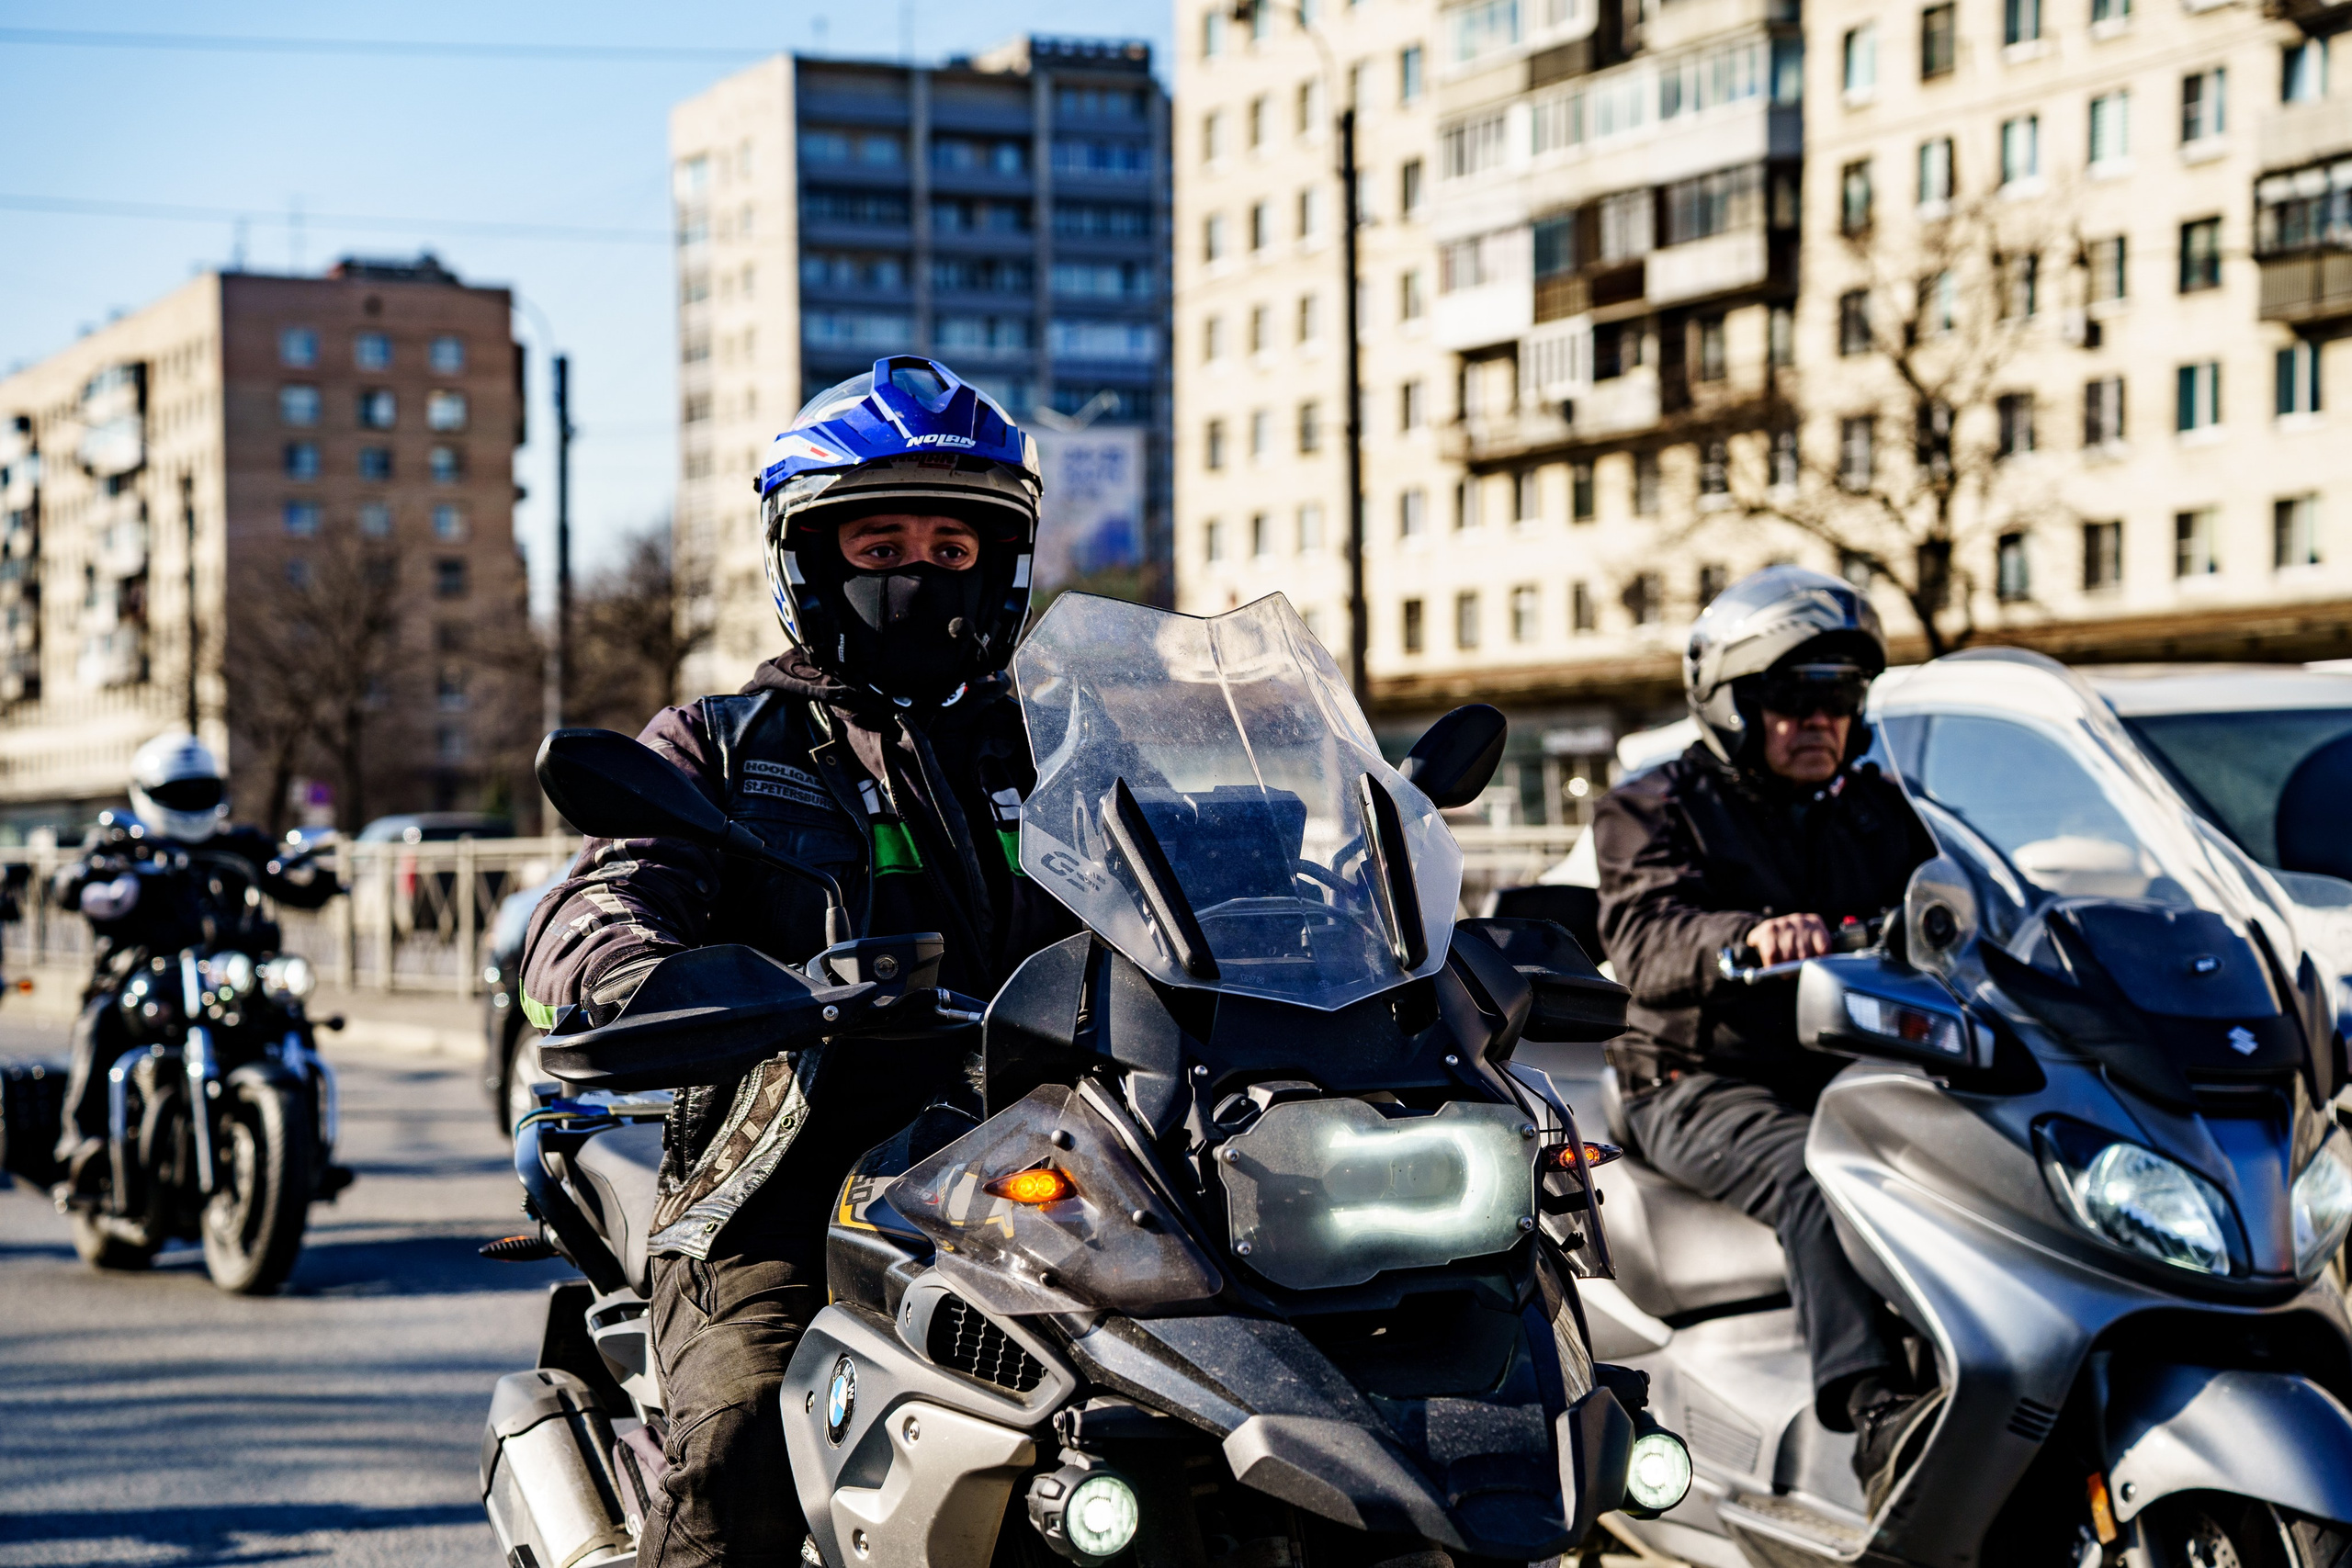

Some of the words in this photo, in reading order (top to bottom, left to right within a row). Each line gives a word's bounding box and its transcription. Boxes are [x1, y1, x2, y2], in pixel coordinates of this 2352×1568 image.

[906, 434, 976, 448] NOLAN
[1041, 851, 1106, 893] GS
[834, 1363, 854, 1400] BMW
